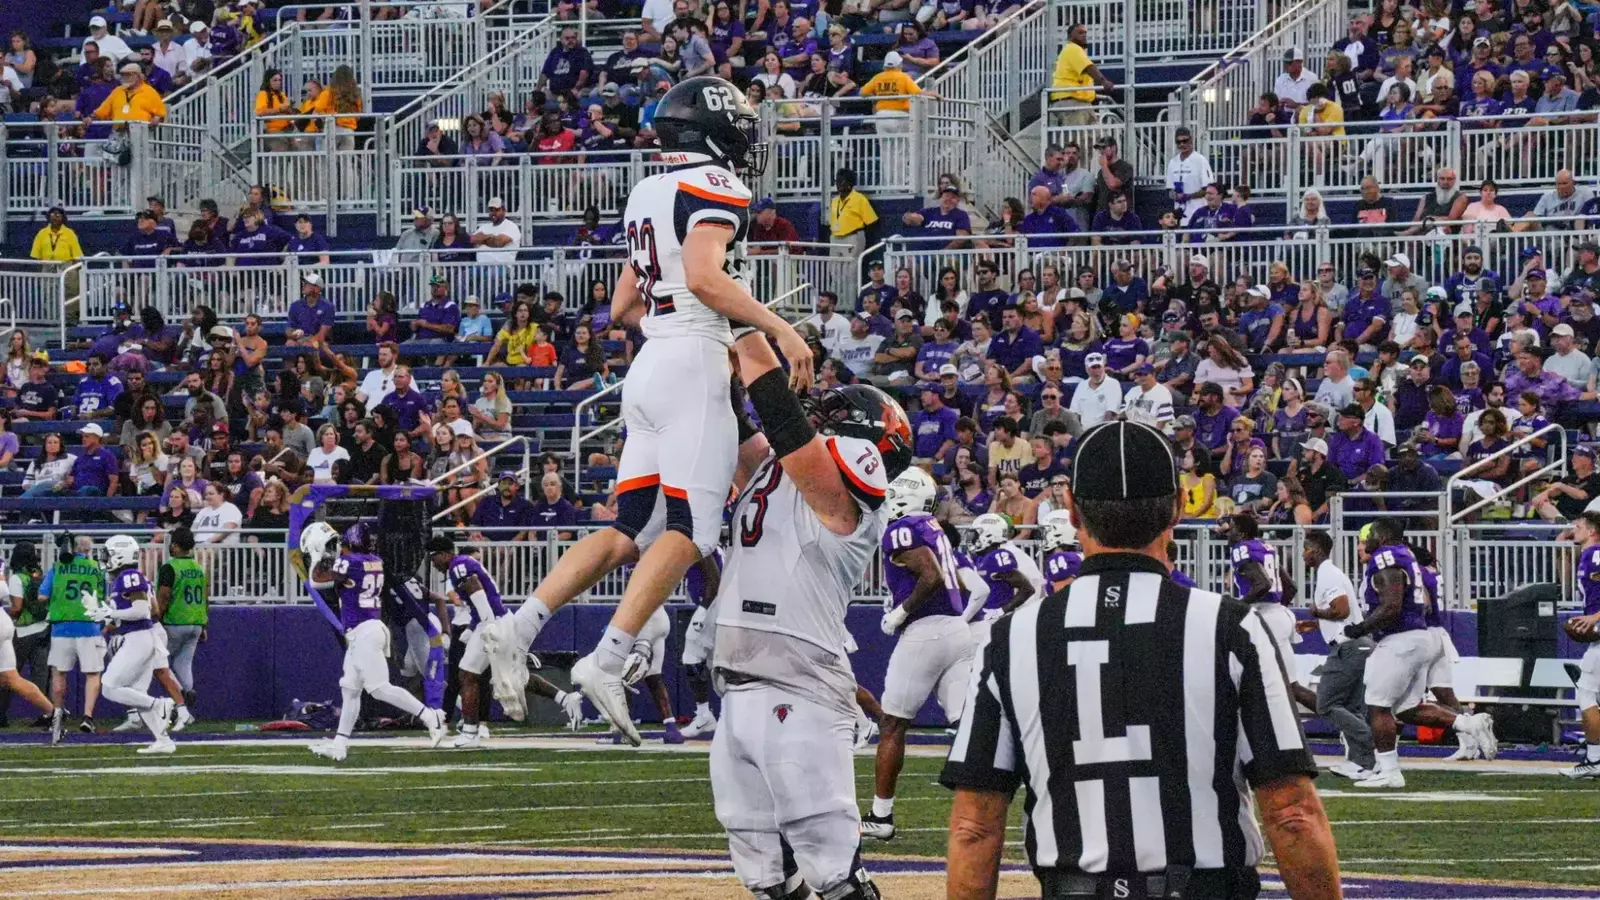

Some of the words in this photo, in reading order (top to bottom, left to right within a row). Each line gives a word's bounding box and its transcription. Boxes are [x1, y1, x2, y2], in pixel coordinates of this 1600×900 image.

[703, 86, 736, 112] 62
[705, 172, 733, 190] 62
[855, 446, 880, 476] 73
[889, 526, 912, 550] 10
[994, 551, 1012, 567] 12
[1232, 544, 1250, 563] 82
[1373, 549, 1396, 571] 55
[58, 563, 99, 576] MEDIA
[332, 558, 350, 575] 23
[452, 562, 468, 580] 15
[122, 572, 141, 589] 83
[183, 584, 203, 605] 60
[1066, 638, 1153, 765] L
